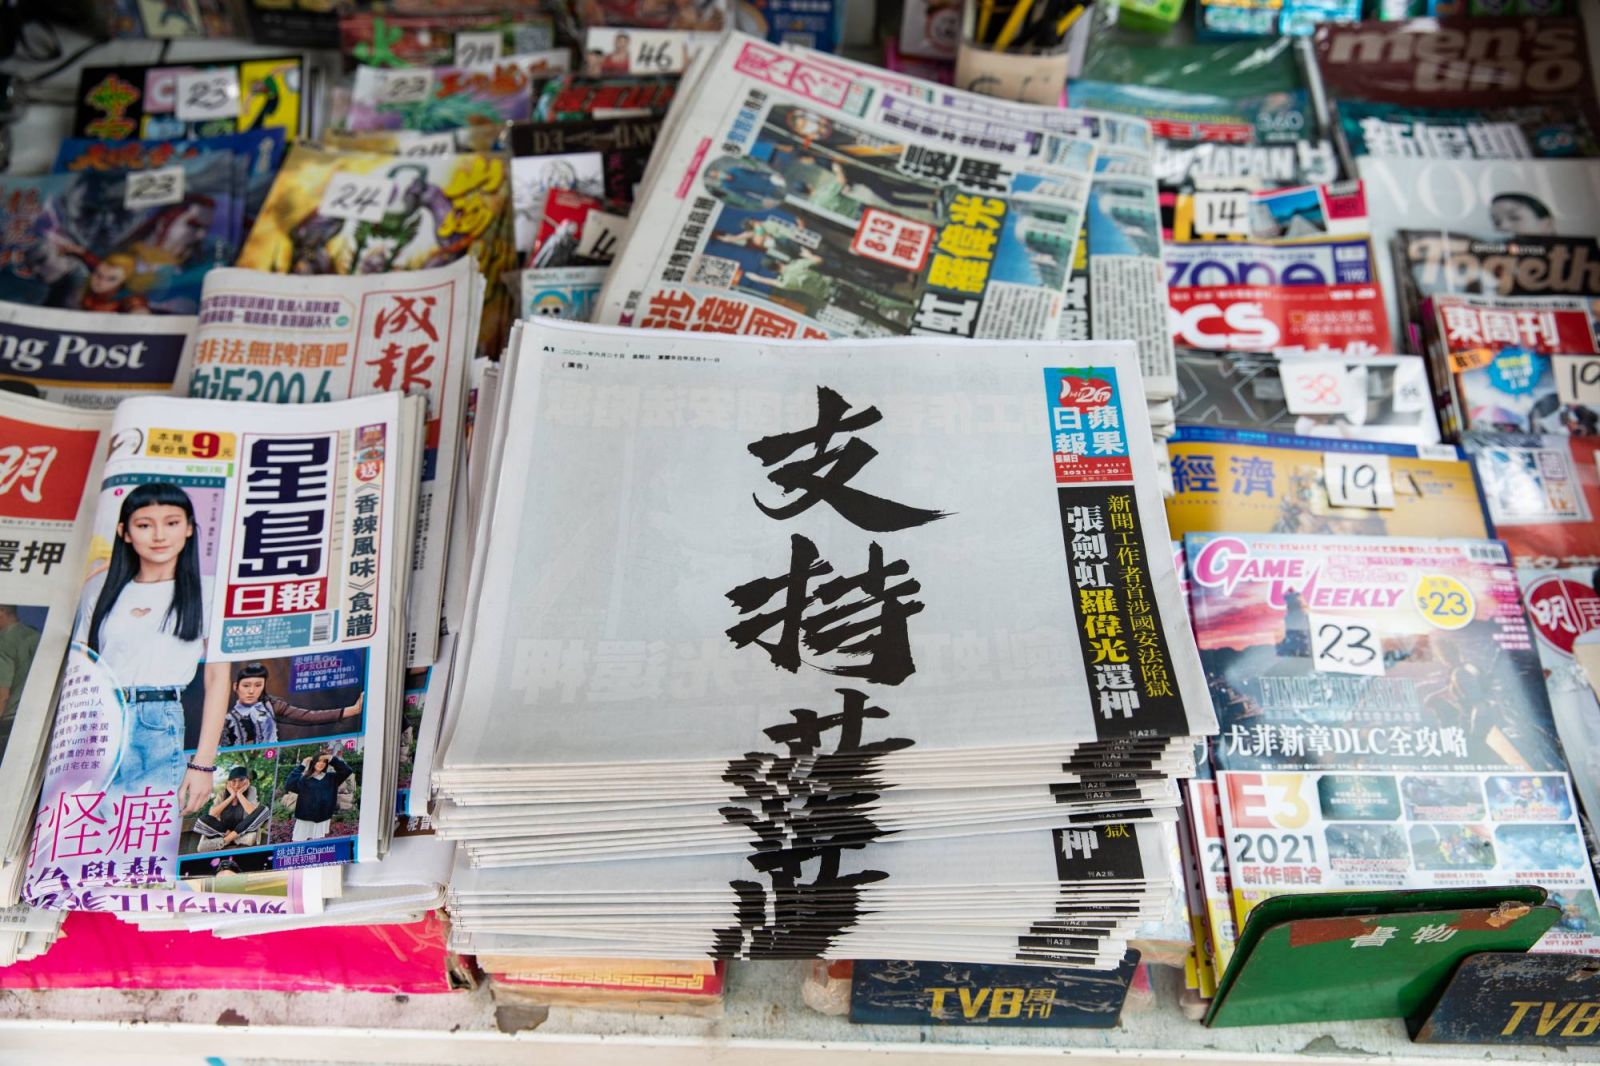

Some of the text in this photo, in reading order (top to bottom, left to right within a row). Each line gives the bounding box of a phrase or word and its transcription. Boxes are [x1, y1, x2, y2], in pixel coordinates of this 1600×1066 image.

[635, 40, 673, 70] 46
[1327, 19, 1580, 64] men's
[1413, 57, 1583, 92] uno
[1207, 200, 1244, 227] 14
[1442, 305, 1560, 347] 東周刊
[51, 334, 150, 369] Post
[197, 339, 348, 368] 非法無牌酒吧
[543, 345, 555, 353] A1
[1296, 372, 1343, 406] 38
[192, 431, 220, 459] 9
[1053, 407, 1088, 456] 日報
[1086, 405, 1125, 455] 蘋果
[1170, 454, 1276, 498] 經濟
[1341, 464, 1378, 504] 19
[238, 435, 331, 579] 星島
[1195, 538, 1304, 592] GAME
[231, 580, 322, 616] 日報
[1107, 494, 1174, 698] 新聞工作者首涉國安法陷獄
[1270, 566, 1405, 607] WEEKLY
[1419, 591, 1468, 616] $23
[1318, 623, 1376, 667] 23
[1225, 723, 1468, 758] 尤菲新章DLC全攻略
[1225, 773, 1311, 829] E3
[306, 844, 336, 855] Chantel
[1234, 833, 1317, 863] 2021
[925, 987, 1024, 1020] TVB
[1501, 1001, 1600, 1037] TVB
